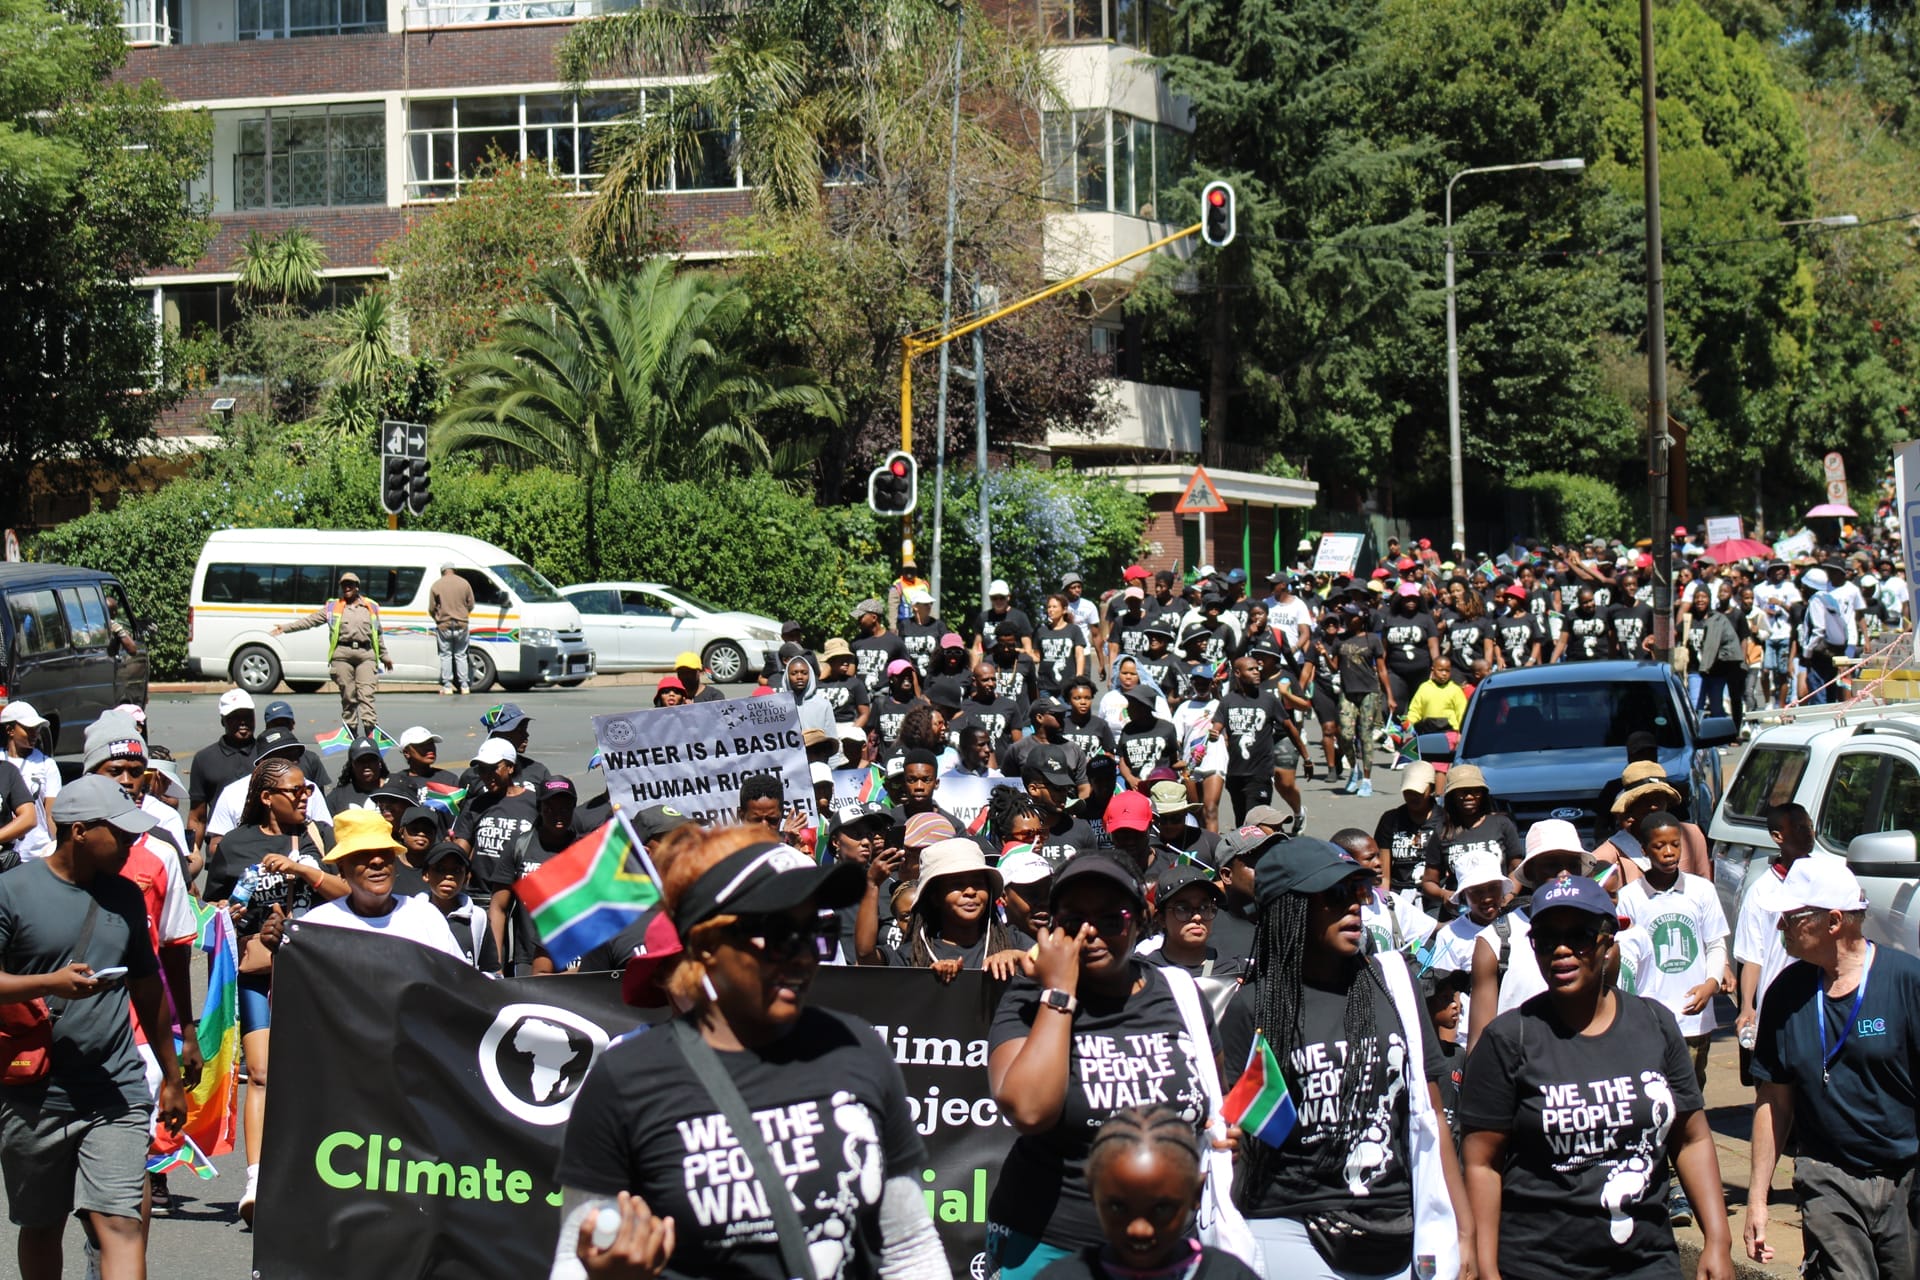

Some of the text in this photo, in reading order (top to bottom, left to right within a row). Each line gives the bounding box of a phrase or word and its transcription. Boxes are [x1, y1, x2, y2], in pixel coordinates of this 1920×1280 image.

[746, 701, 774, 710] CIVIC
[749, 706, 787, 718] ACTION
[751, 714, 786, 725] TEAMS
[605, 730, 801, 770] WATER IS A BASIC
[631, 775, 712, 802] HUMAN
[477, 827, 512, 841] PEOPLE
[498, 818, 517, 830] THE
[477, 837, 504, 851] WALK
[1042, 846, 1060, 858] THE
[1545, 888, 1580, 900] GBVF
[1857, 1018, 1886, 1034] LRC
[1074, 1032, 1174, 1059] WE, THE
[1291, 1043, 1334, 1074] WE,
[1079, 1054, 1176, 1082] PEOPLE
[1082, 1078, 1169, 1109] WALK
[1540, 1076, 1637, 1108] WE, THE
[752, 1101, 824, 1143] THE
[1542, 1102, 1634, 1134] PEOPLE
[1545, 1128, 1619, 1155] WALK
[315, 1131, 533, 1204] Climate
[683, 1136, 821, 1190] PEOLE
